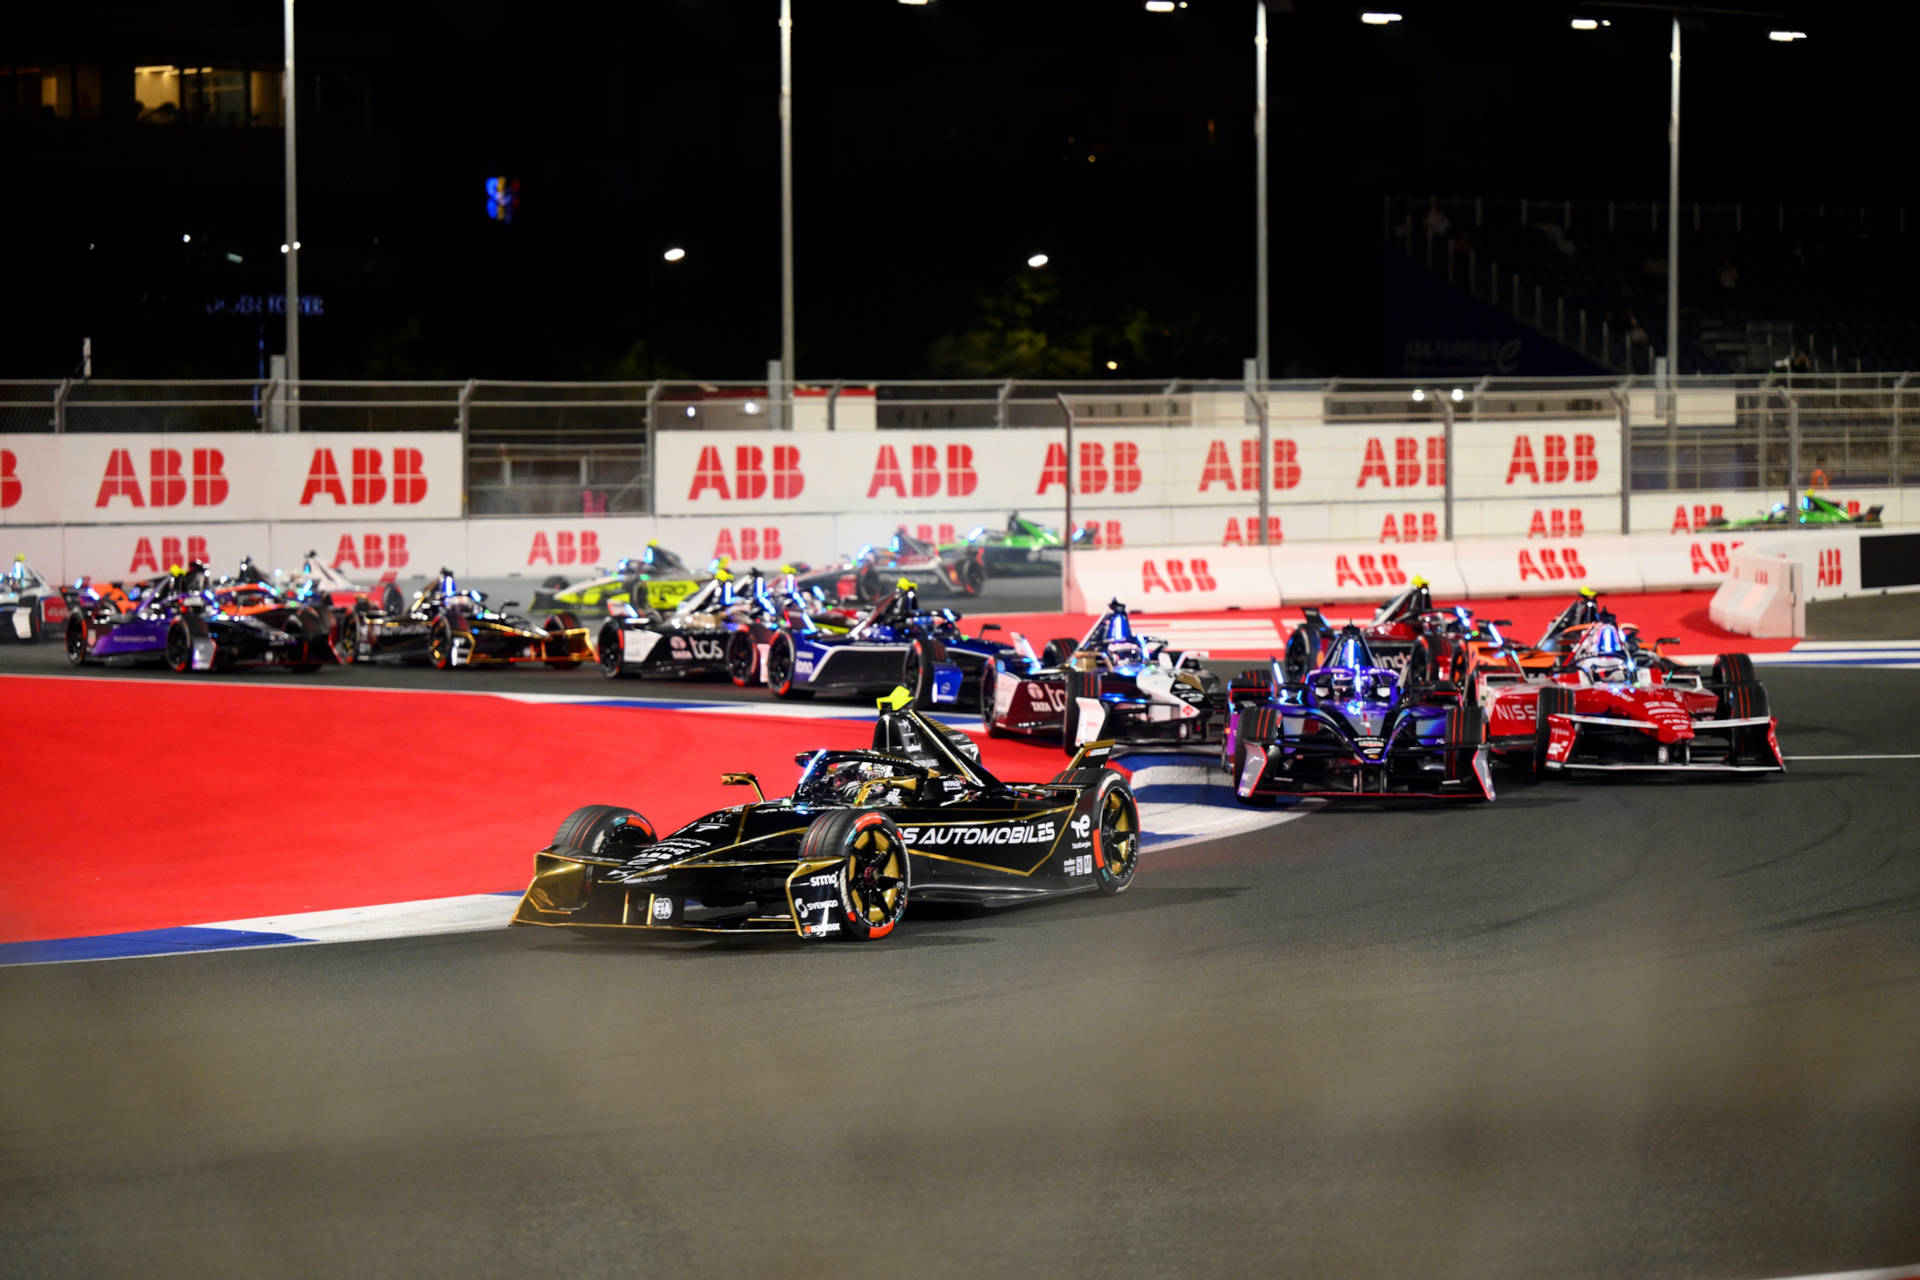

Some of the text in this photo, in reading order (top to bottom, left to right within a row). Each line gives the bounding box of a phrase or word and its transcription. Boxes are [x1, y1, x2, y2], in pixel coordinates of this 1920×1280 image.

[300, 448, 428, 506] ABB
[688, 445, 805, 500] ABB
[867, 444, 978, 498] ABB
[1037, 442, 1142, 495] ABB
[1199, 439, 1301, 491] ABB
[1357, 437, 1446, 488] ABB
[1506, 434, 1598, 485] ABB
[96, 448, 229, 508] ABB
[1379, 512, 1438, 543] ABB
[1528, 509, 1584, 538] ABB
[129, 536, 210, 574] ABB
[330, 533, 409, 568] ABB
[528, 531, 600, 565] ABB
[713, 528, 782, 560] ABB
[1690, 541, 1744, 575] AB
[1142, 558, 1217, 593] ABB
[1335, 553, 1407, 588] ABB
[1518, 547, 1587, 581] ABB
[1818, 548, 1842, 587] ABB
[1044, 683, 1066, 713] tc
[1495, 703, 1537, 721] NISS
[918, 821, 1056, 845] AUTOMOBILES
